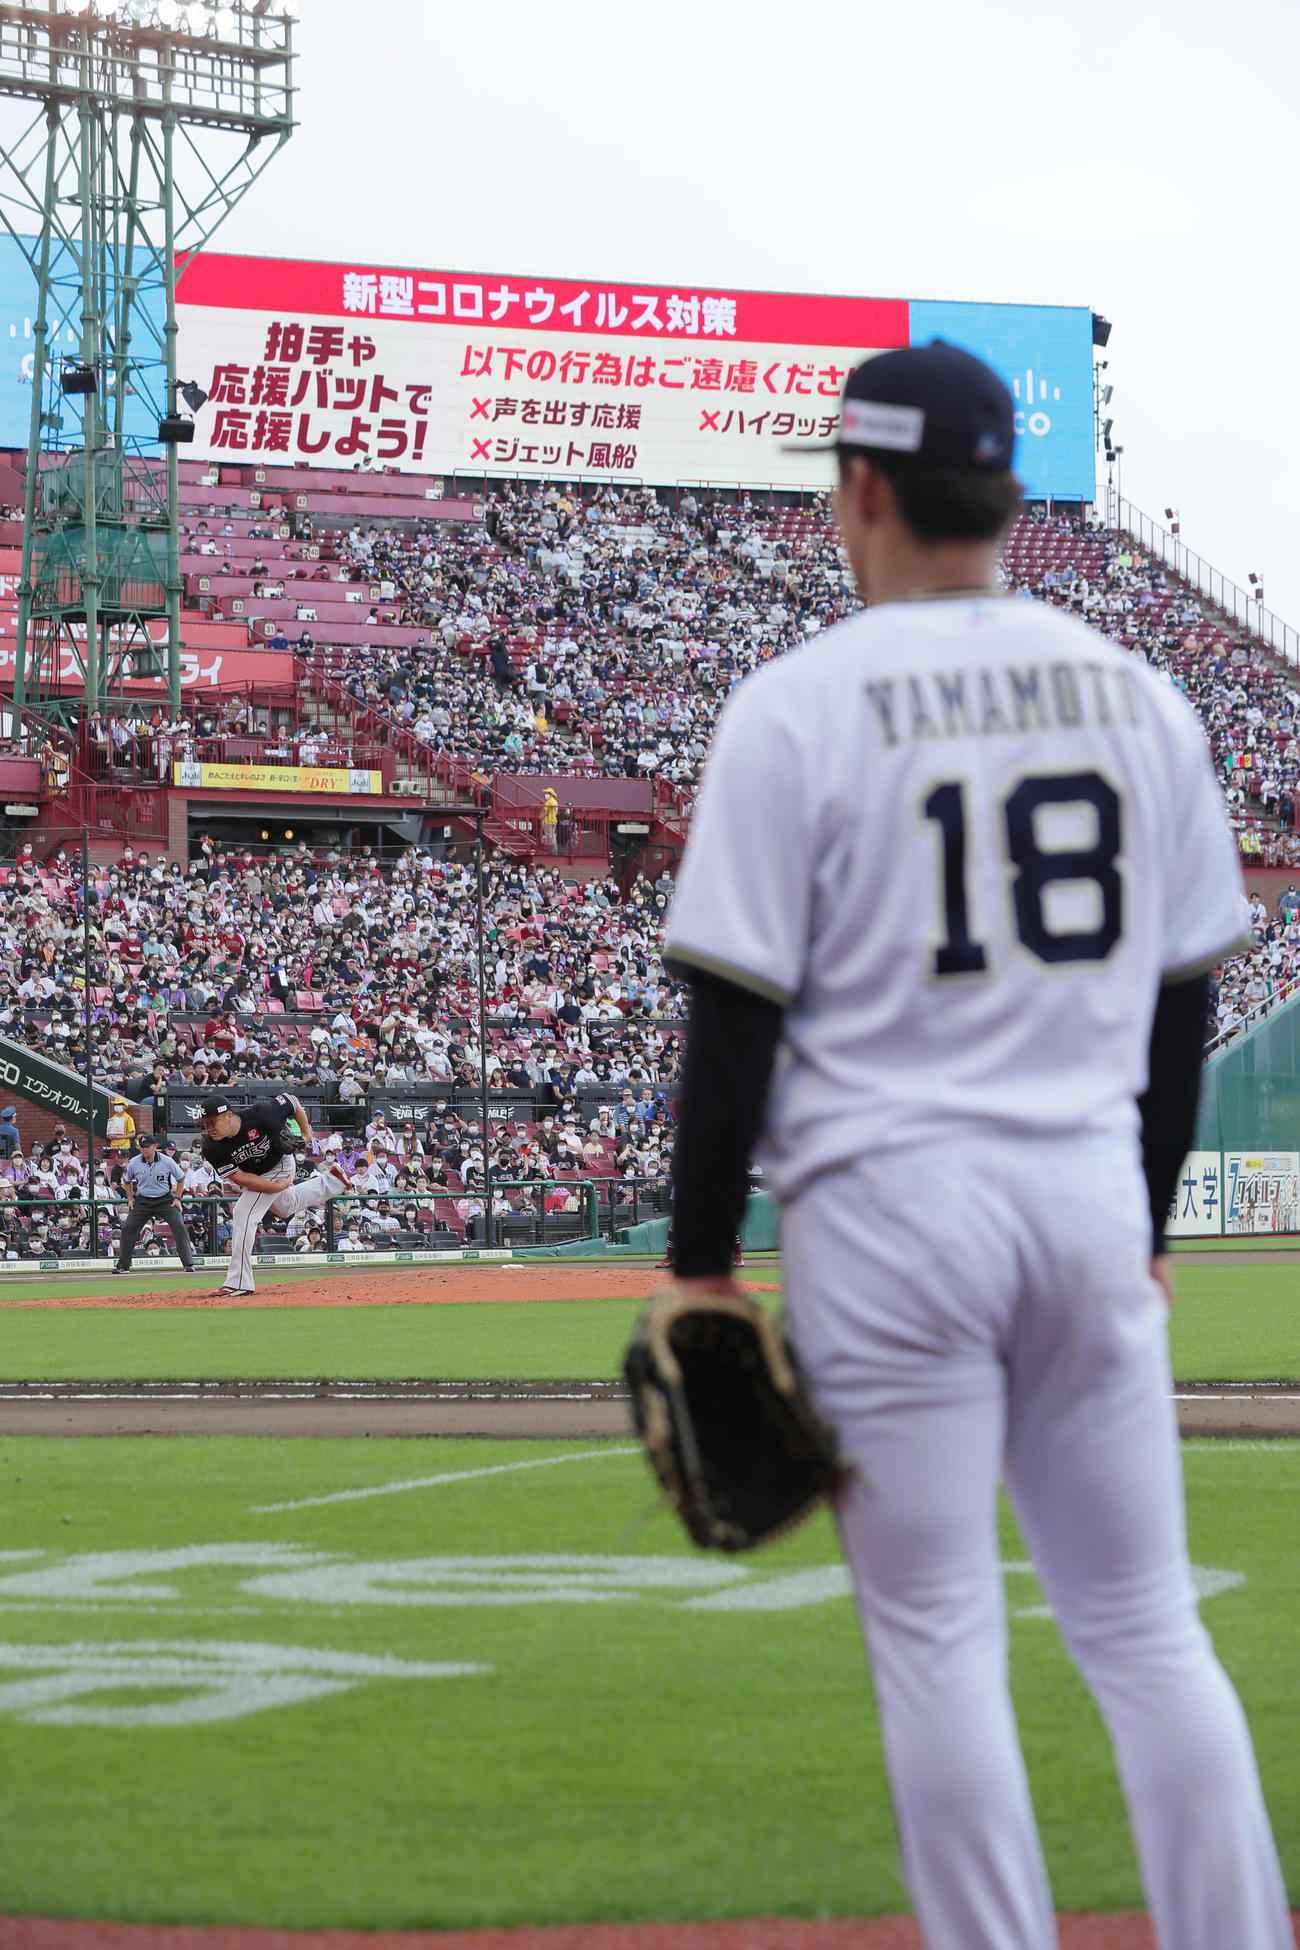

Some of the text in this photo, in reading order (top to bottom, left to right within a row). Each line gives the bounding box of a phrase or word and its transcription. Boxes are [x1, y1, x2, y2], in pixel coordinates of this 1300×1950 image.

[342, 271, 737, 336] 新型コロナウイルス対策
[263, 321, 376, 367] 拍手や
[208, 363, 432, 415] 応援バットで
[492, 397, 642, 430] 声を出す応援
[493, 437, 637, 469] ジェット風船
[915, 767, 1127, 988] 18
